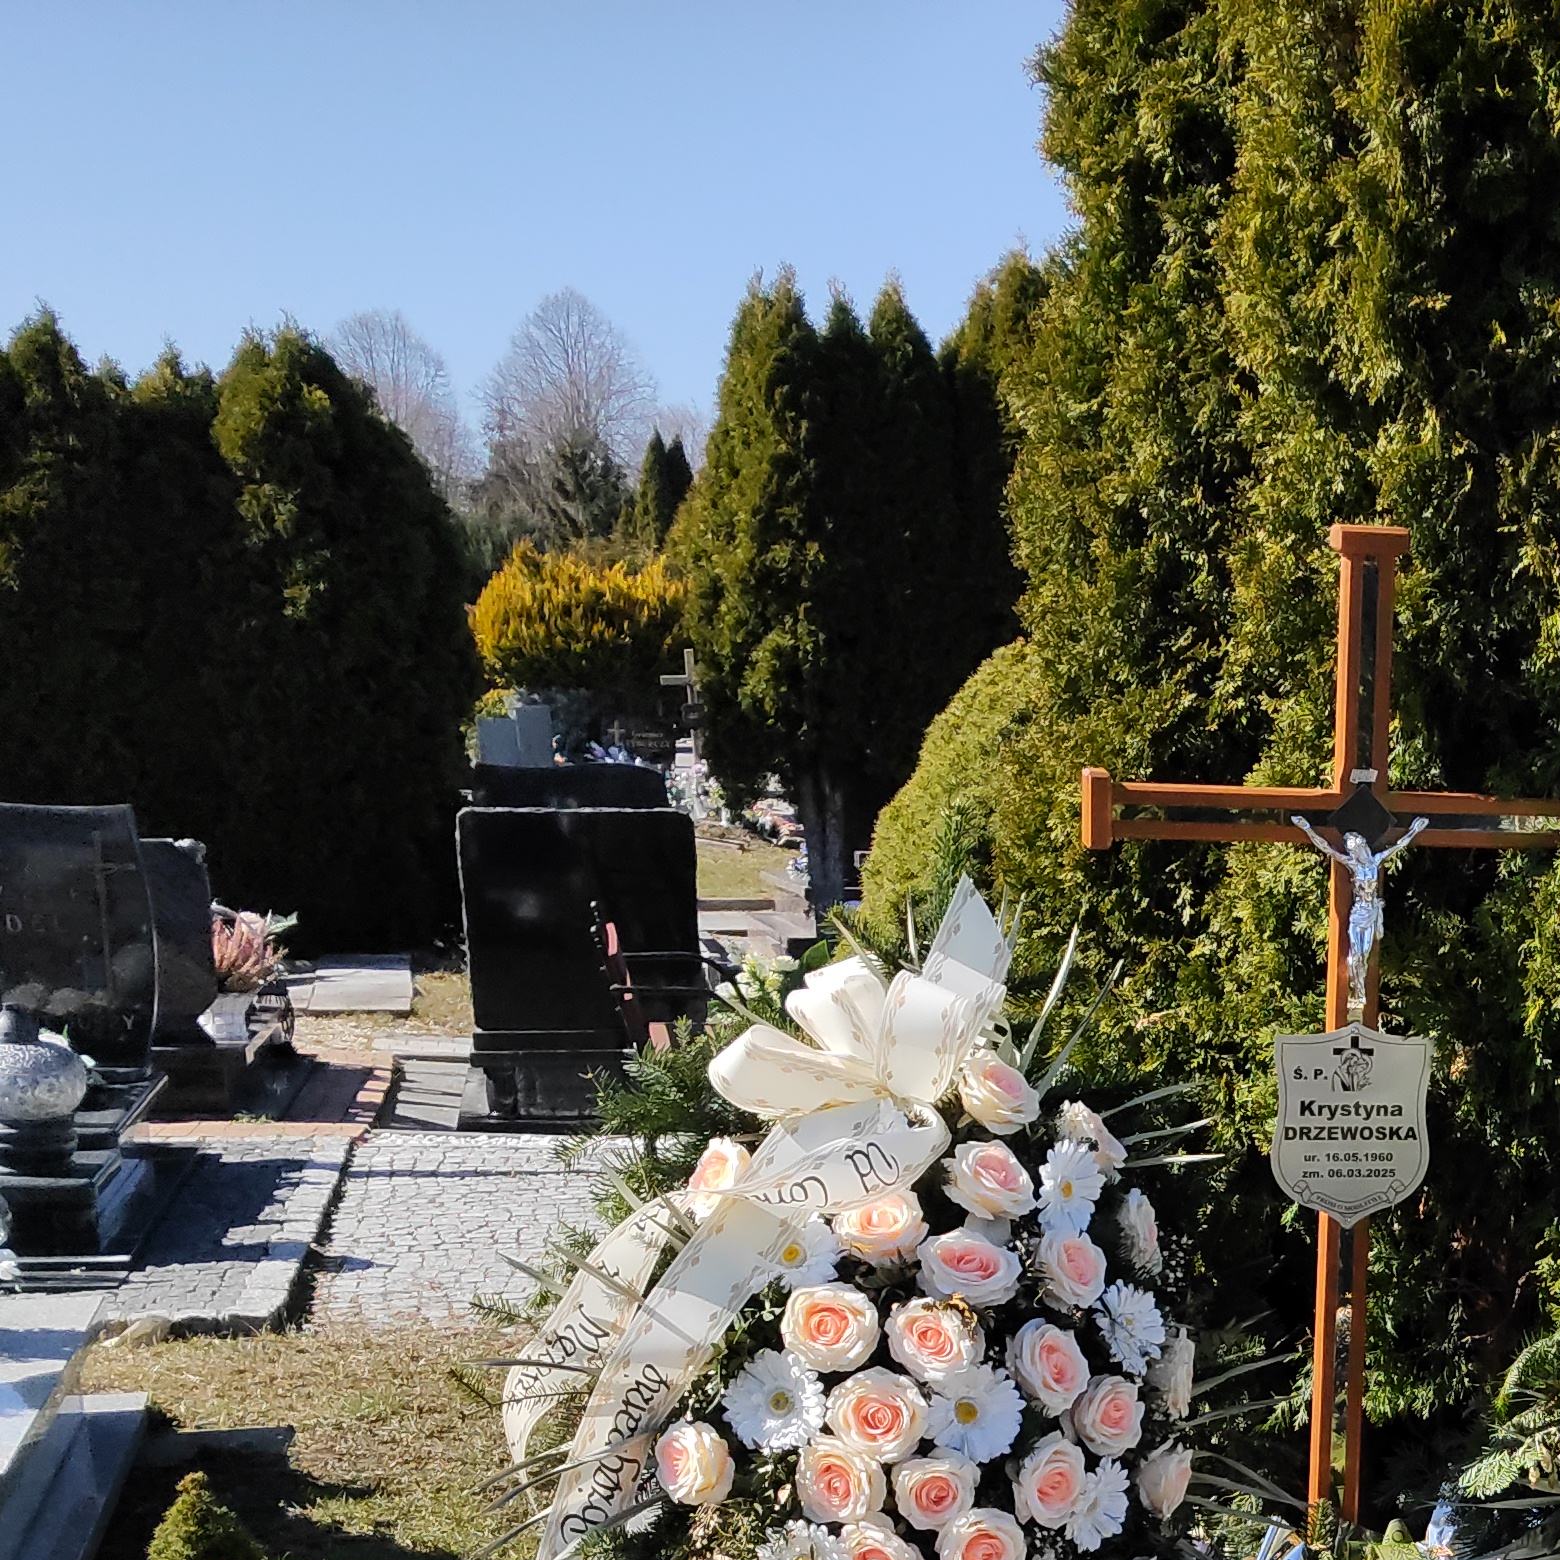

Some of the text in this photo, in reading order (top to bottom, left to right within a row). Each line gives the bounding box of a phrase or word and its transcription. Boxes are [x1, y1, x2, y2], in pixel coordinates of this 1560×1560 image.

[1293, 1065, 1328, 1080] Ś. P.
[1299, 1100, 1403, 1121] Krystyna
[1284, 1126, 1417, 1141] DRZEWOSKA
[843, 1139, 900, 1190] Od
[1303, 1152, 1394, 1162] ur. 16.05.1960
[1302, 1168, 1396, 1178] zm. 06.03.2025
